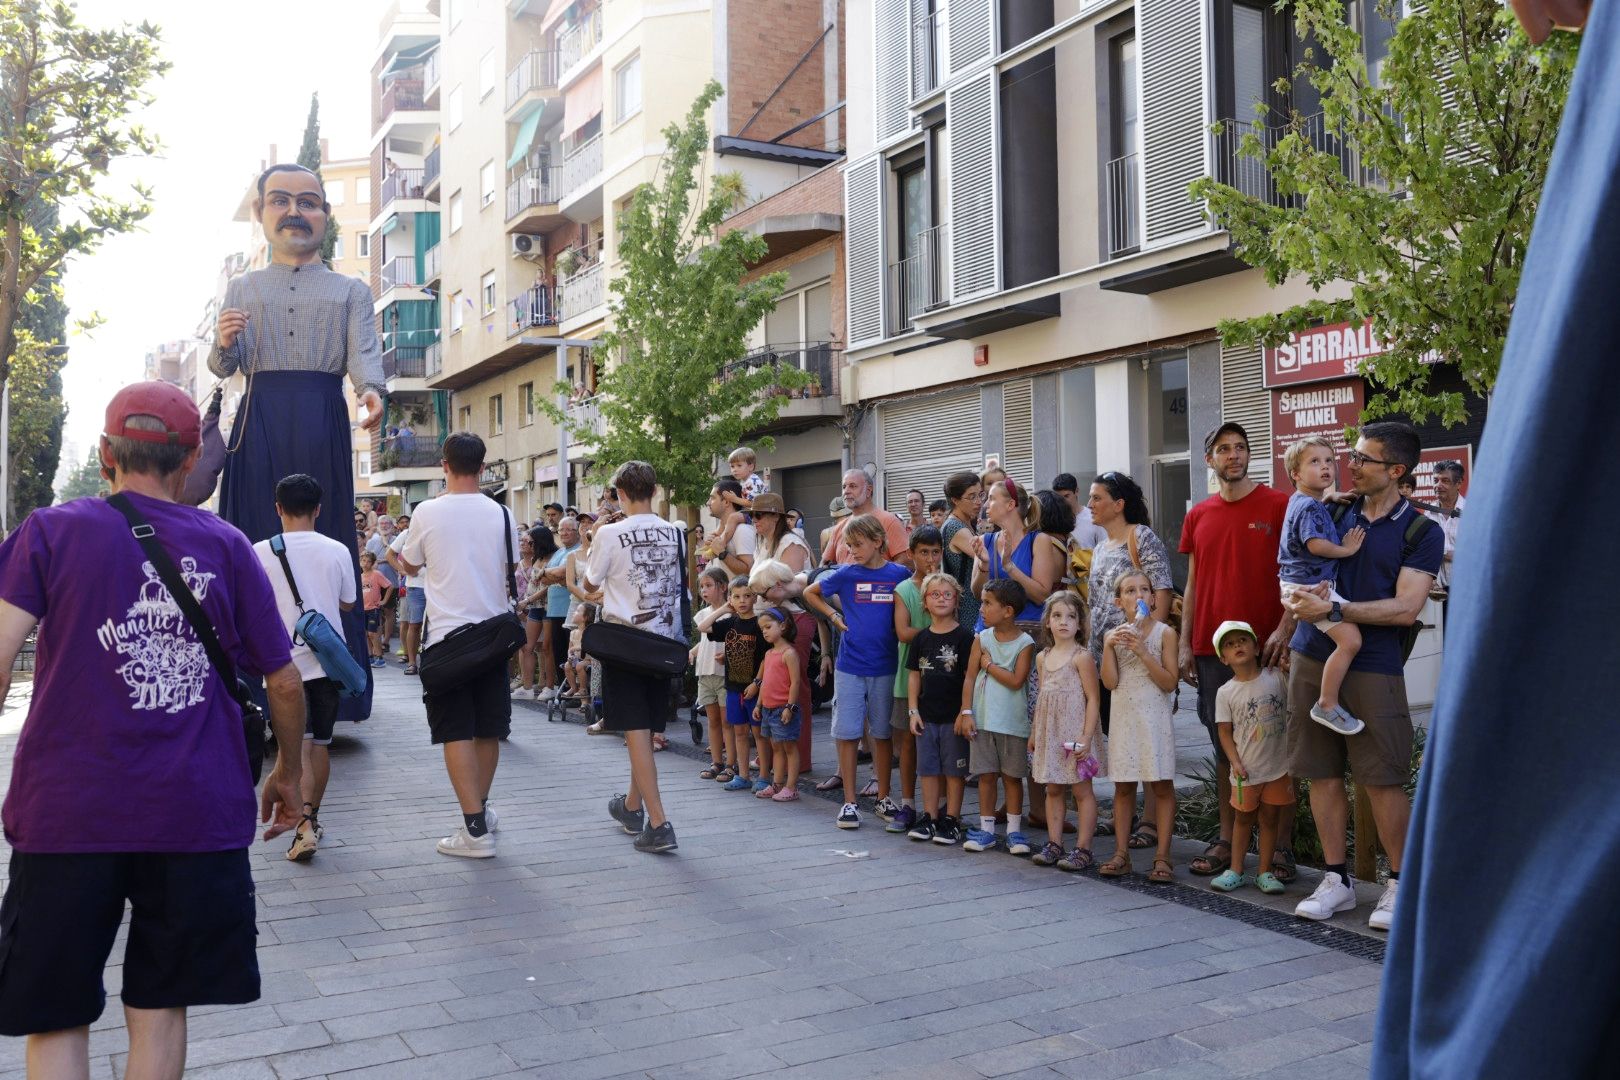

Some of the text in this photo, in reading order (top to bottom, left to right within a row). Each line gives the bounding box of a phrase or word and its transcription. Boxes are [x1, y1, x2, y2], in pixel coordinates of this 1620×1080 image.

[1169, 397, 1187, 415] 49
[1280, 387, 1355, 413] SERRALLERIA
[1295, 407, 1338, 428] MANEL
[97, 607, 175, 652] Manelic
[176, 615, 186, 636] i
